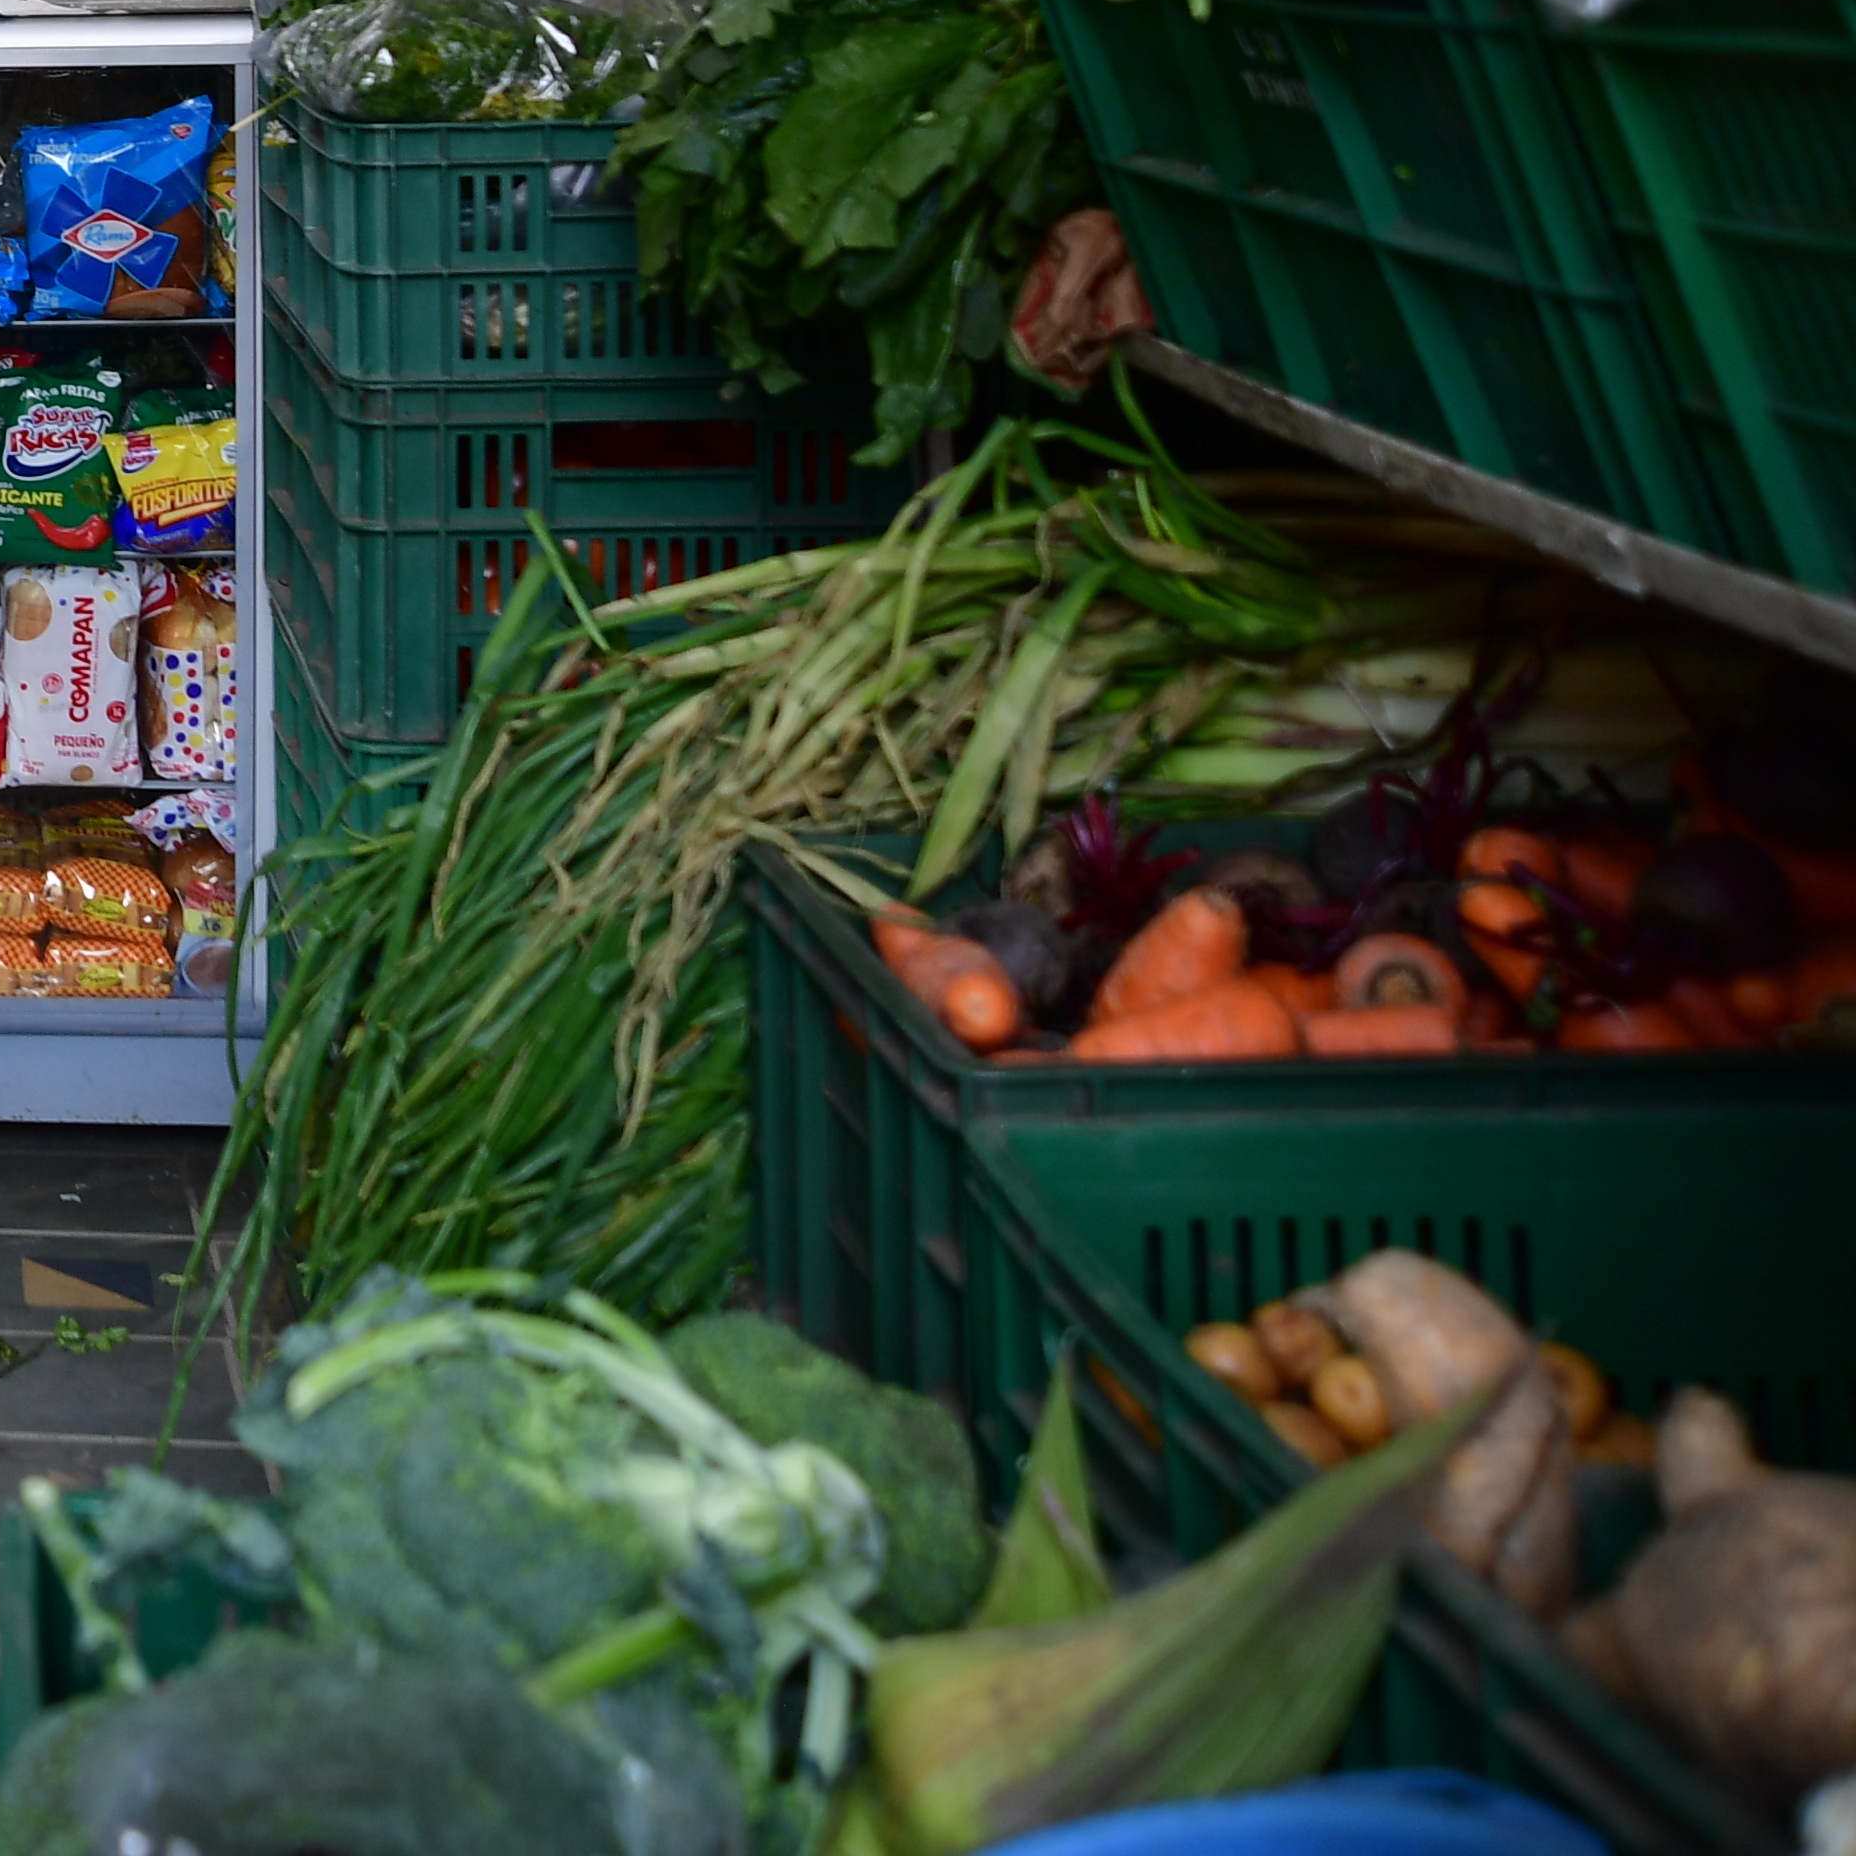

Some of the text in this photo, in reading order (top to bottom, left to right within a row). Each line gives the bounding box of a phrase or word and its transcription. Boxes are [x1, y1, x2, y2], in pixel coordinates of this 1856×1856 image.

[60, 384, 106, 403] FRITAS
[32, 404, 96, 426] SUPER
[9, 427, 102, 454] RICAS
[68, 596, 95, 724] COMAPAN
[54, 732, 106, 750] PEQUEÑO
